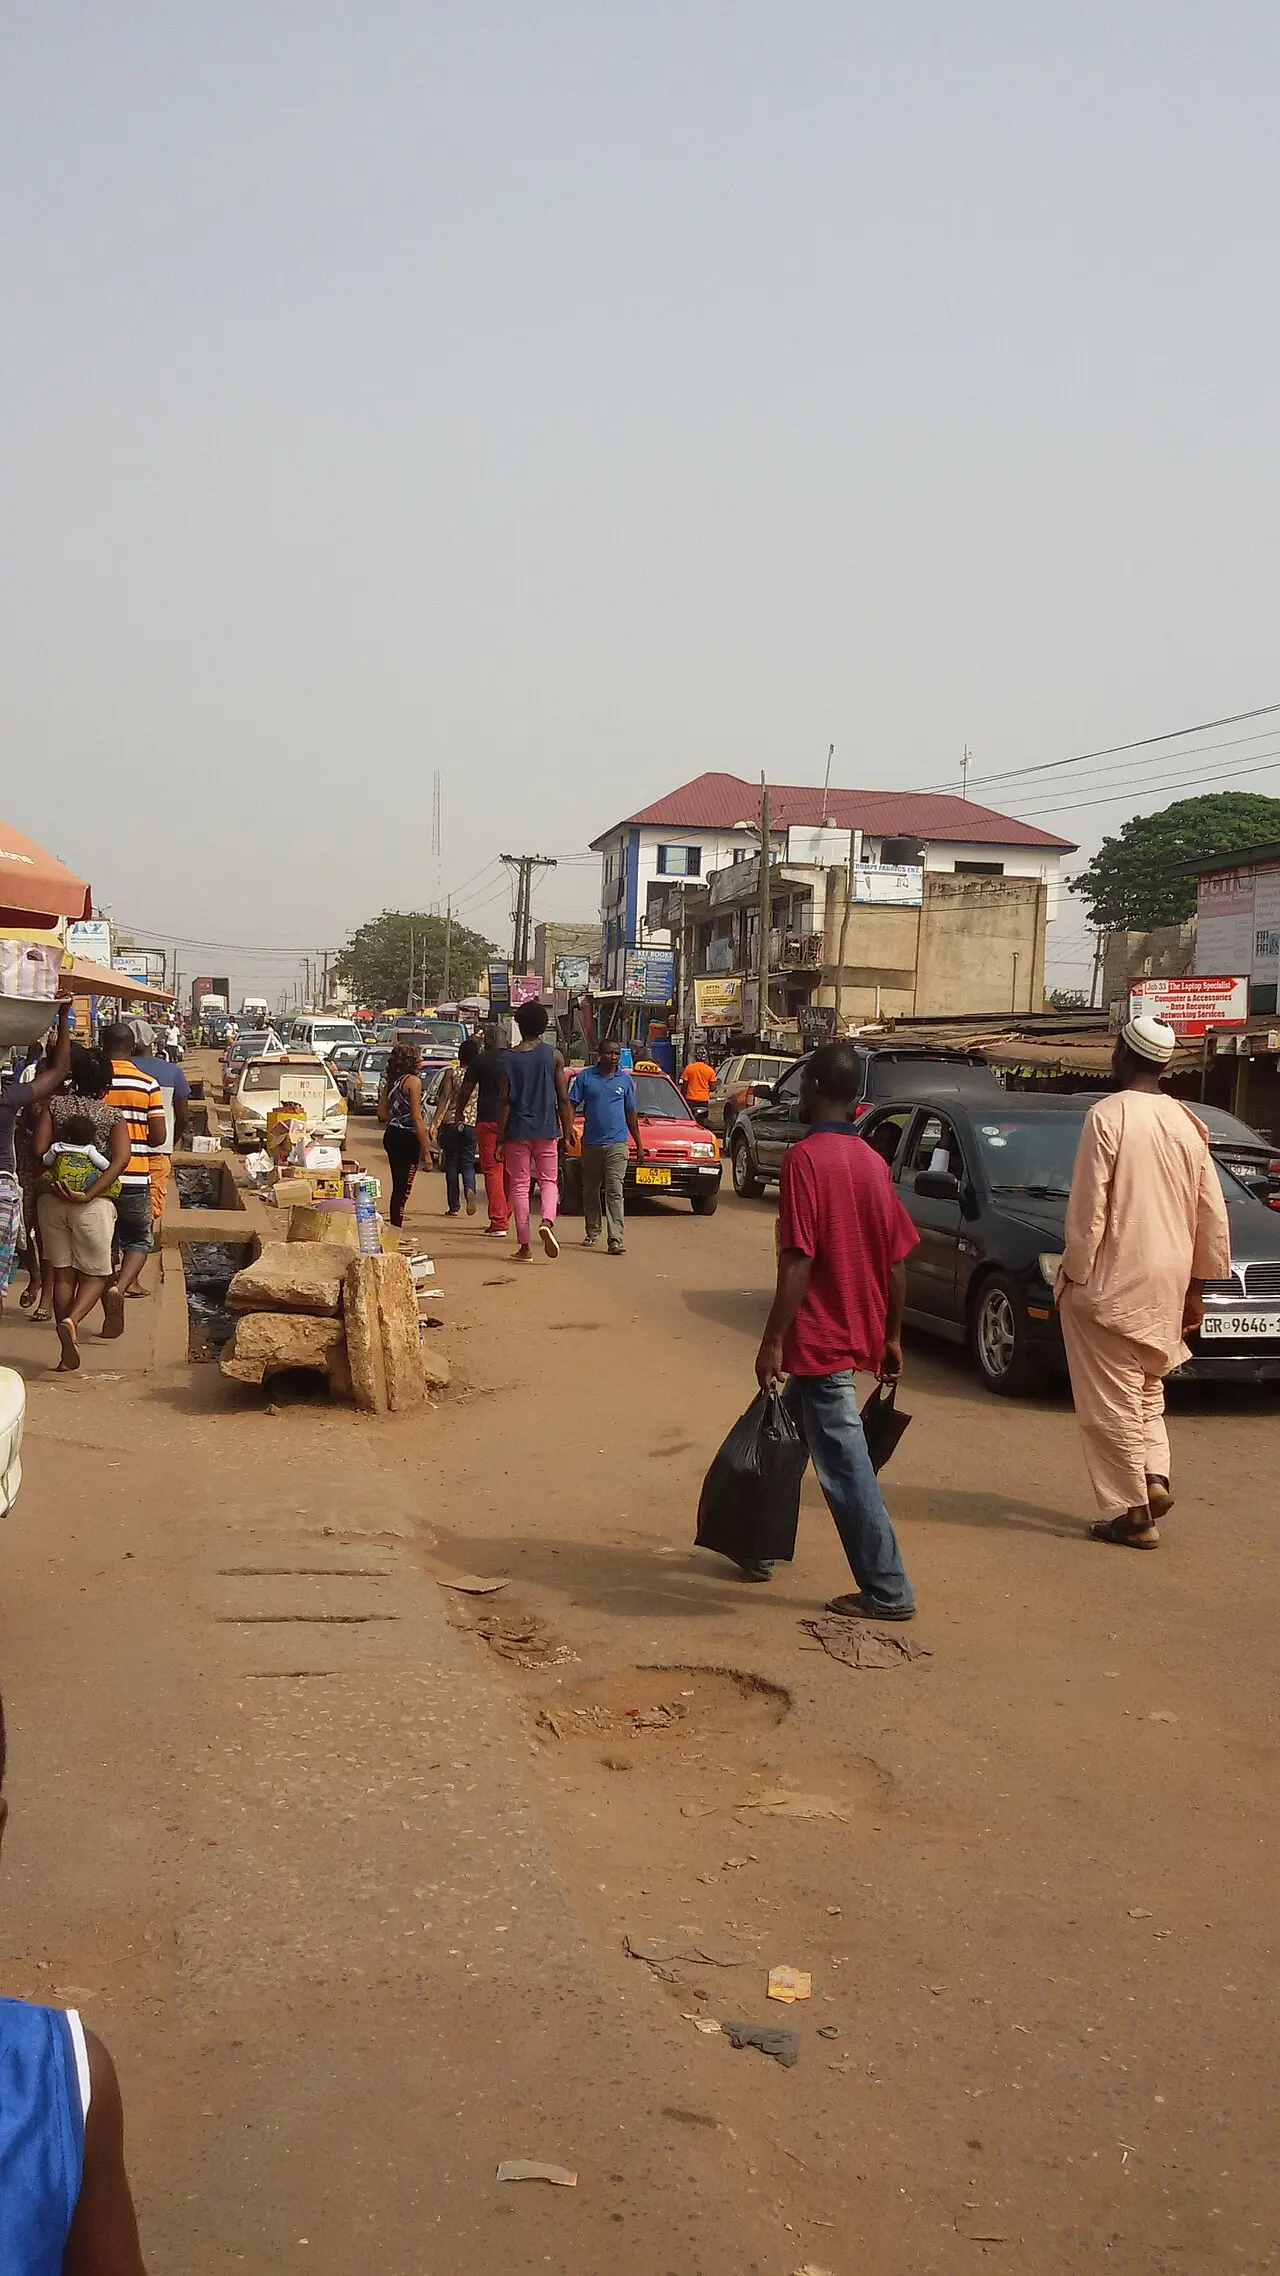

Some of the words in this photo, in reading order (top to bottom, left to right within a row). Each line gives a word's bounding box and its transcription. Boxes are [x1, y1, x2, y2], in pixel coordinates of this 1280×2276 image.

[1146, 982, 1158, 991] Job
[1159, 982, 1167, 991] 33
[1170, 982, 1180, 990] The
[1181, 982, 1202, 992] Laptop
[1203, 981, 1231, 992] Specialist
[1154, 995, 1186, 1003] Computer
[1186, 1002, 1216, 1010] Recovery
[1160, 1011, 1196, 1019] Networking
[639, 1064, 658, 1072] TAXI
[649, 1168, 659, 1176] GS
[1205, 1318, 1223, 1333] GR
